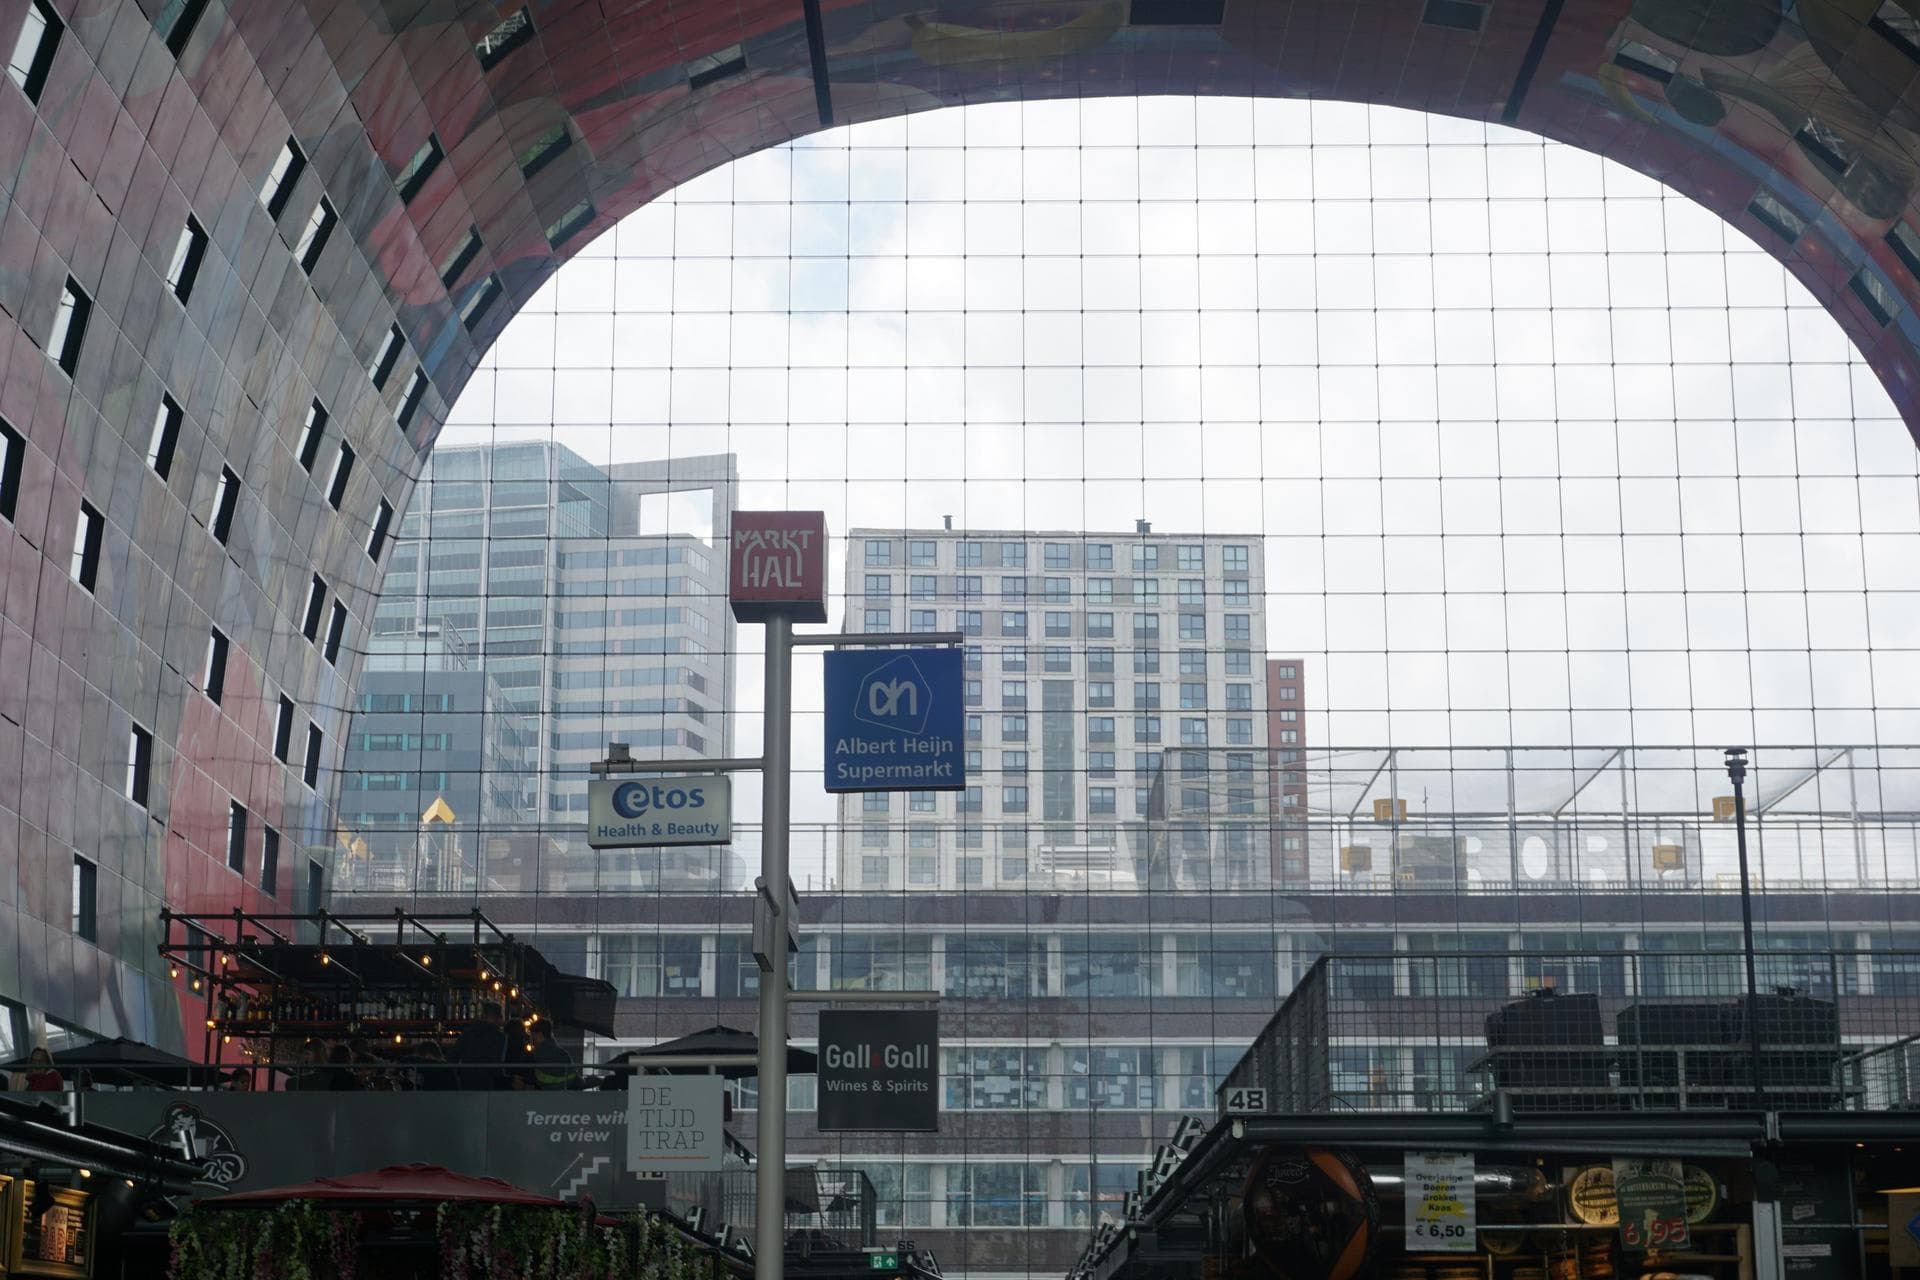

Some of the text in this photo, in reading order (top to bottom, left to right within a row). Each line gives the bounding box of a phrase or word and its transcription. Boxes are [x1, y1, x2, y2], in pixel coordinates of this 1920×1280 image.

[734, 528, 815, 549] MARKT
[742, 555, 803, 588] HAL
[836, 736, 954, 757] Albert Heijn
[837, 760, 953, 783] Supermarkt
[612, 781, 705, 819] etos
[597, 820, 720, 838] Health & Beauty
[825, 1043, 871, 1069] Gall
[884, 1043, 929, 1069] Gall
[640, 1087, 672, 1106] DE
[826, 1079, 929, 1094] Wines & Spirits
[1229, 1090, 1264, 1110] 48
[526, 1111, 592, 1126] Terrace
[640, 1108, 696, 1128] TIJD
[550, 1128, 611, 1143] a view
[640, 1130, 705, 1150] TRAP
[1428, 1204, 1453, 1212] Kaas
[1415, 1224, 1466, 1240] € 6,50
